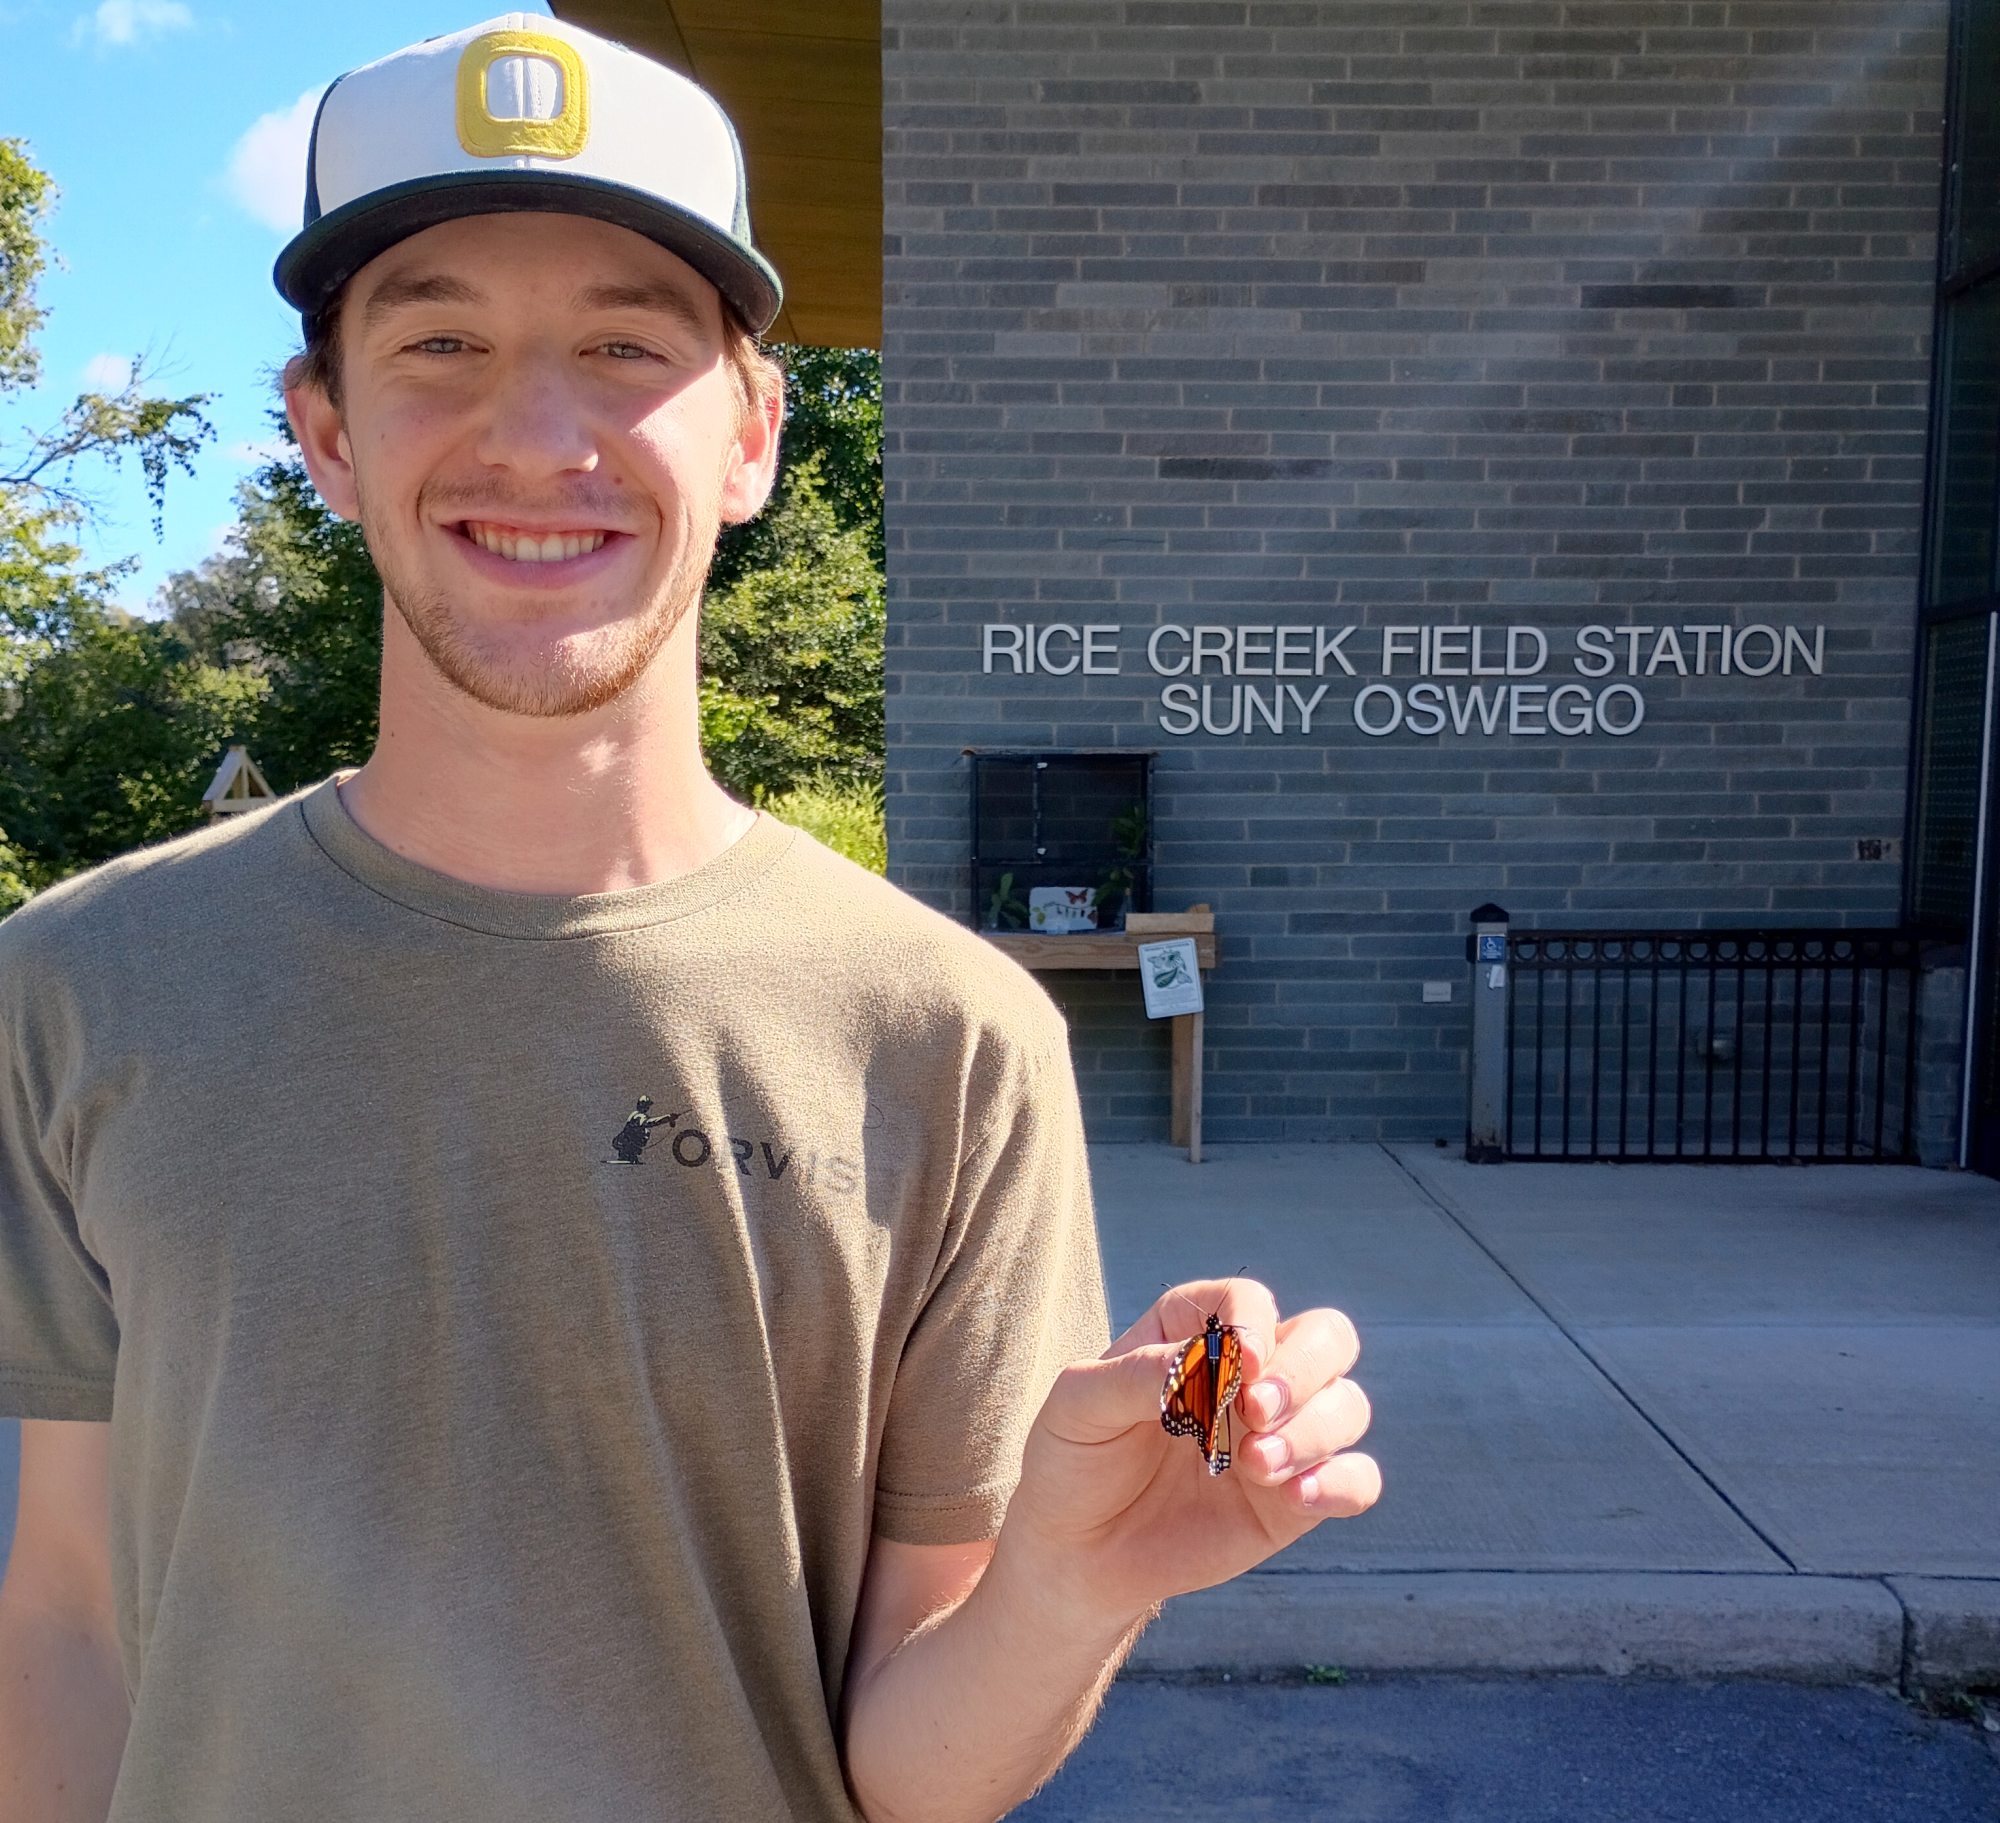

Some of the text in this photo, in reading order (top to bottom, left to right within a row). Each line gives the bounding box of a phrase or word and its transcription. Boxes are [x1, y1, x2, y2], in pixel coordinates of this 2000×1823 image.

[455, 29, 591, 159] O
[982, 623, 1825, 677] RICE CREEK FIELD STATION
[1159, 683, 1645, 737] SUNY OSWEGO
